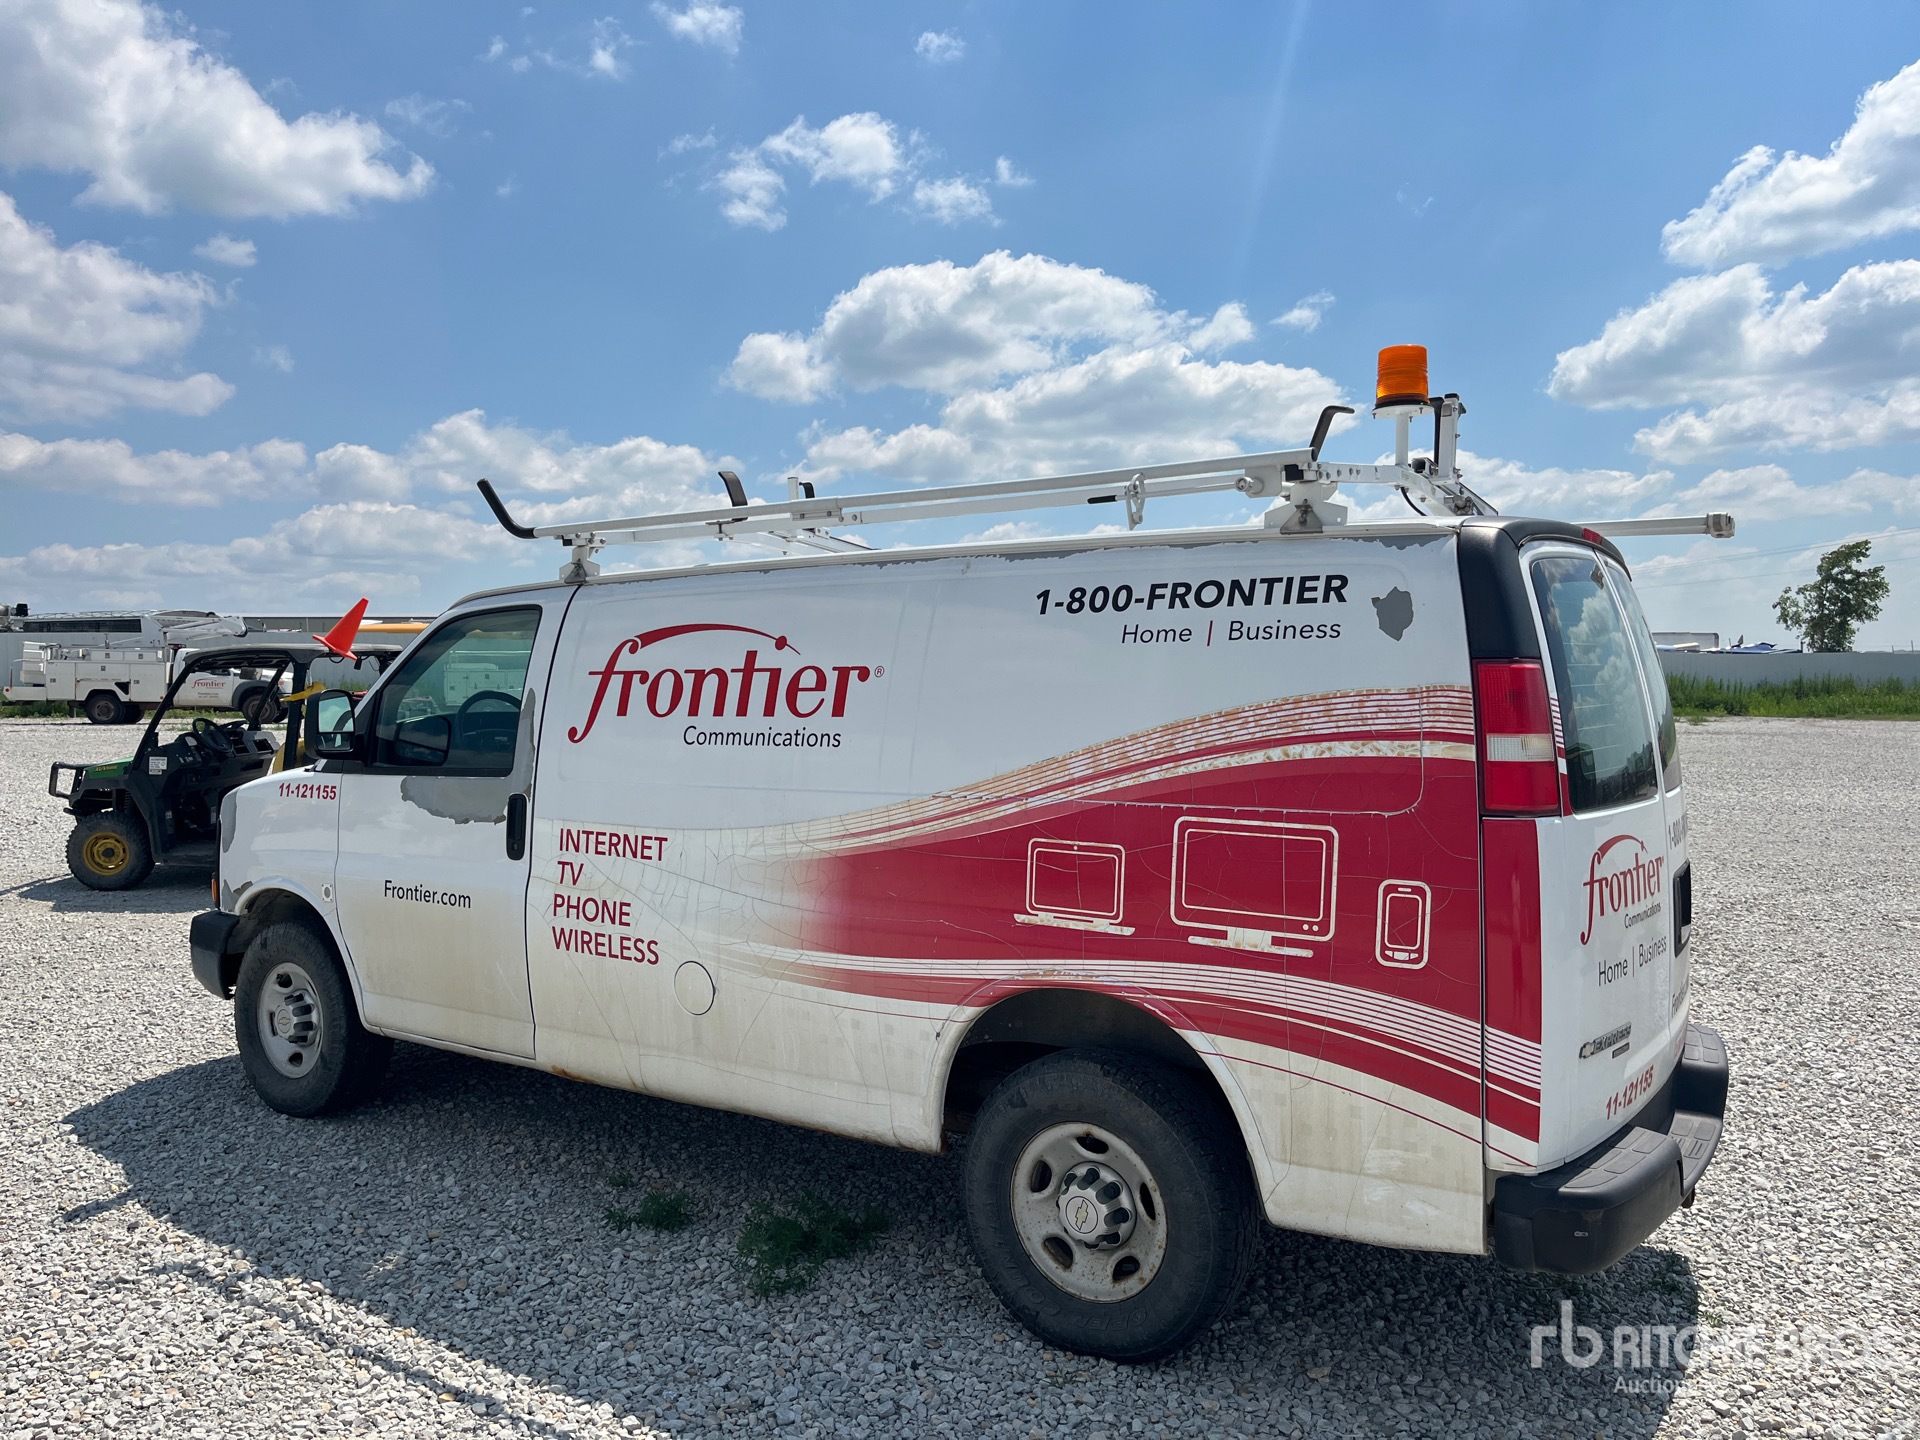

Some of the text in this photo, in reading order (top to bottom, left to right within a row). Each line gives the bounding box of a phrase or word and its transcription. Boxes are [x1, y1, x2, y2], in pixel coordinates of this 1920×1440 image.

[1035, 573, 1349, 615] 1-800-FRONTIER
[1121, 623, 1193, 645] Home
[1228, 618, 1342, 642] Business
[192, 679, 226, 689] frontier
[567, 637, 872, 744] frontier
[682, 725, 841, 748] Communications
[278, 782, 337, 801] 11-121155
[558, 827, 669, 862] INTERNET
[557, 860, 585, 886] TV
[383, 879, 472, 909] Frontier.com
[552, 893, 632, 927] PHONE
[1580, 850, 1663, 946] frontier
[1624, 900, 1662, 930] Communications
[551, 925, 660, 966] WIRELESS
[1598, 957, 1629, 987] Home
[1638, 934, 1668, 968] Business
[1605, 1064, 1655, 1120] 11-121155
